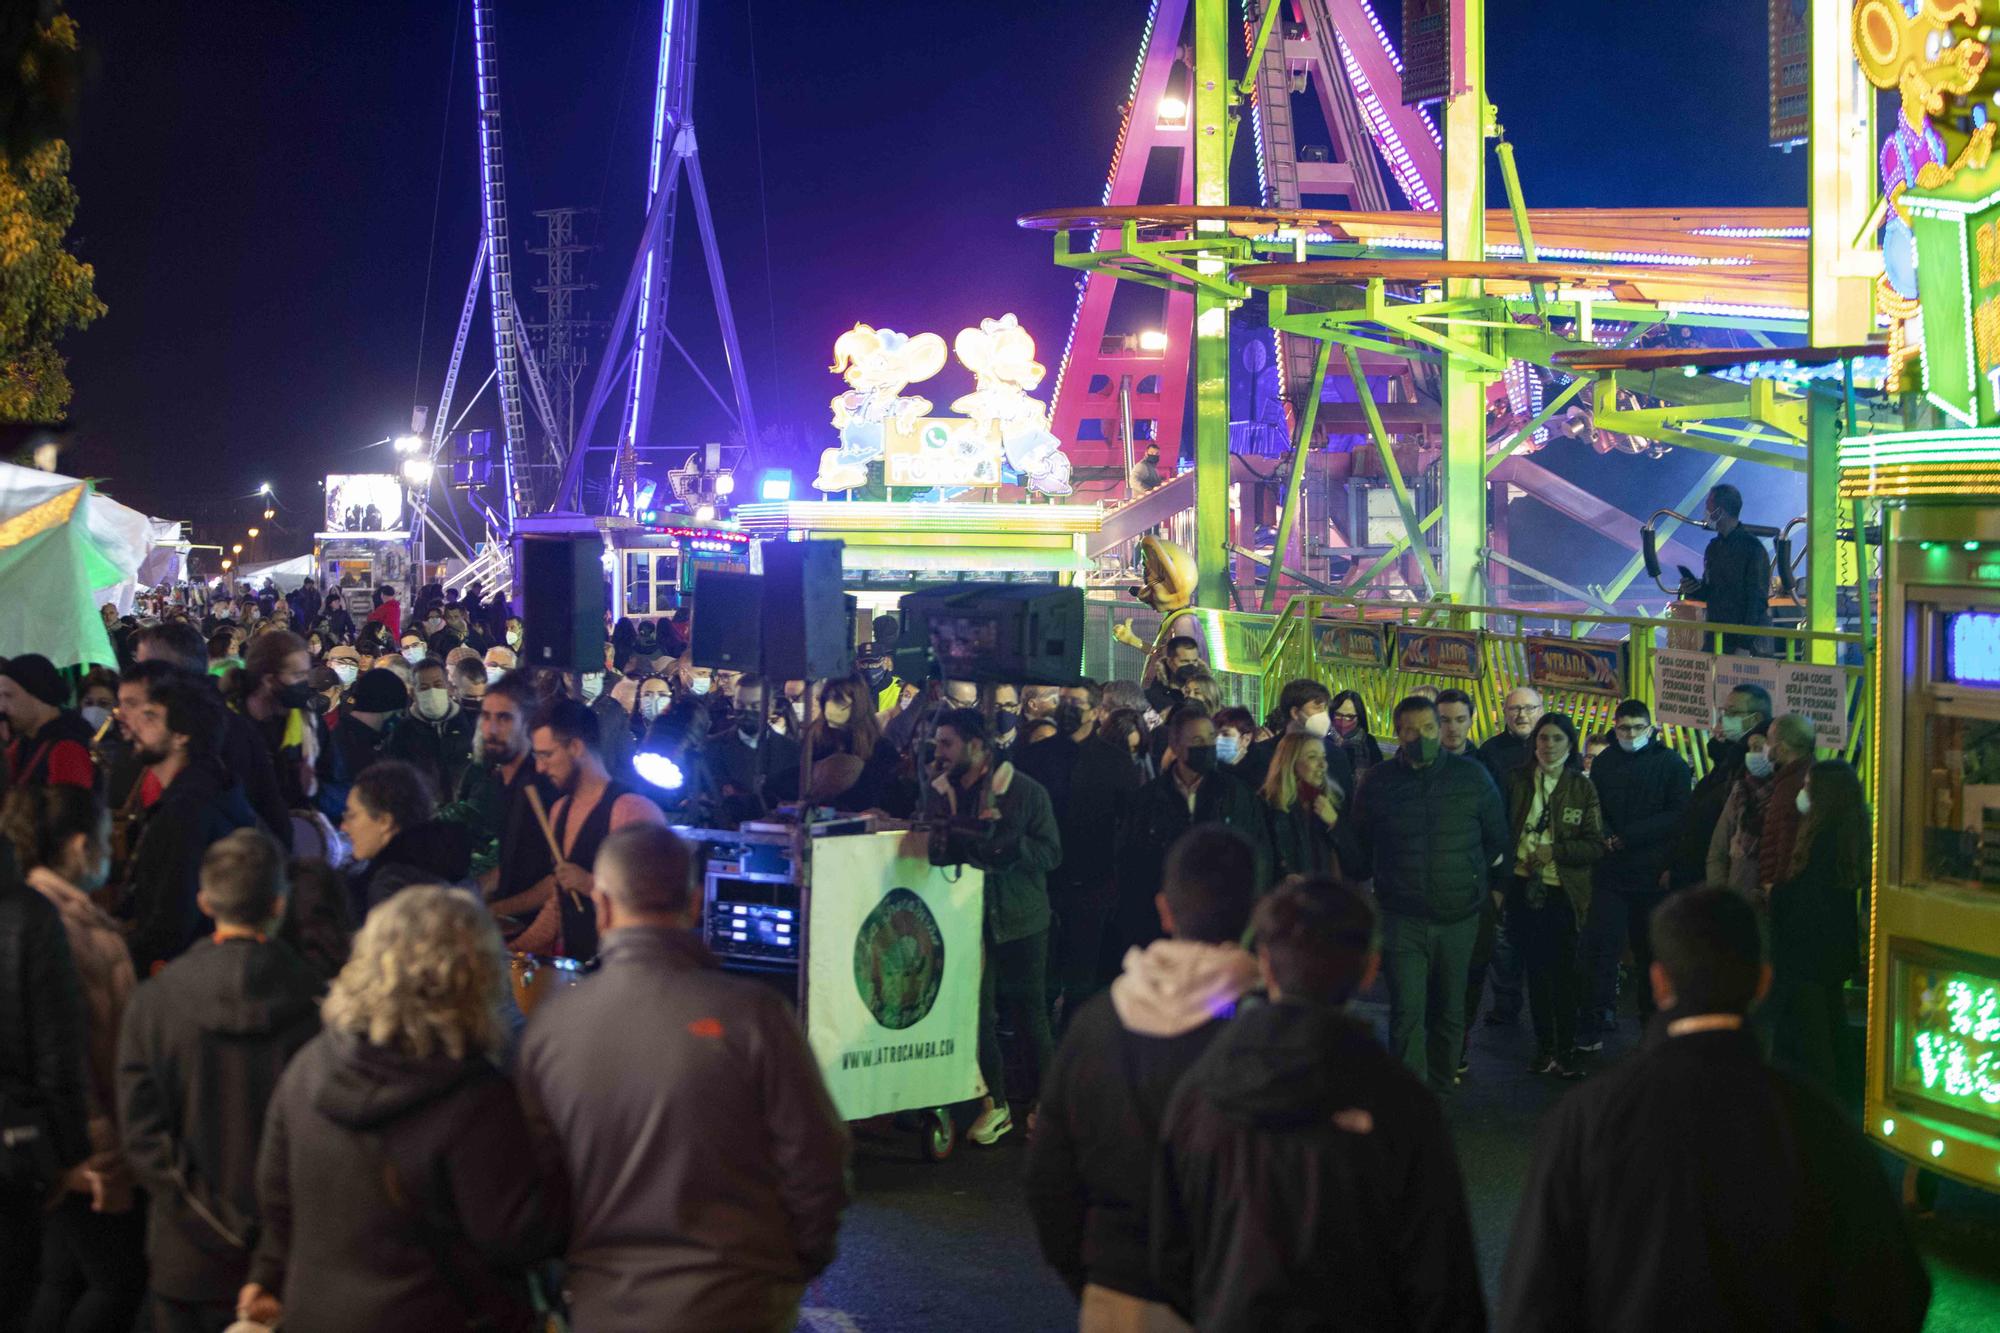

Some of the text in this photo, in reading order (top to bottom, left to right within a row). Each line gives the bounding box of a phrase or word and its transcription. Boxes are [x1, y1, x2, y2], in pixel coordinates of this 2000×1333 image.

[1528, 643, 1589, 680] ENTRADA
[1658, 655, 1674, 666] CADA
[1674, 658, 1694, 669] COCHE
[1693, 671, 1705, 682] POR
[1791, 671, 1832, 685] CADA COCHE
[1662, 679, 1705, 694] PERSONAS QUE
[1658, 702, 1709, 718] MISMO DOMICILIO
[1787, 695, 1836, 710] POR PERSONAS
